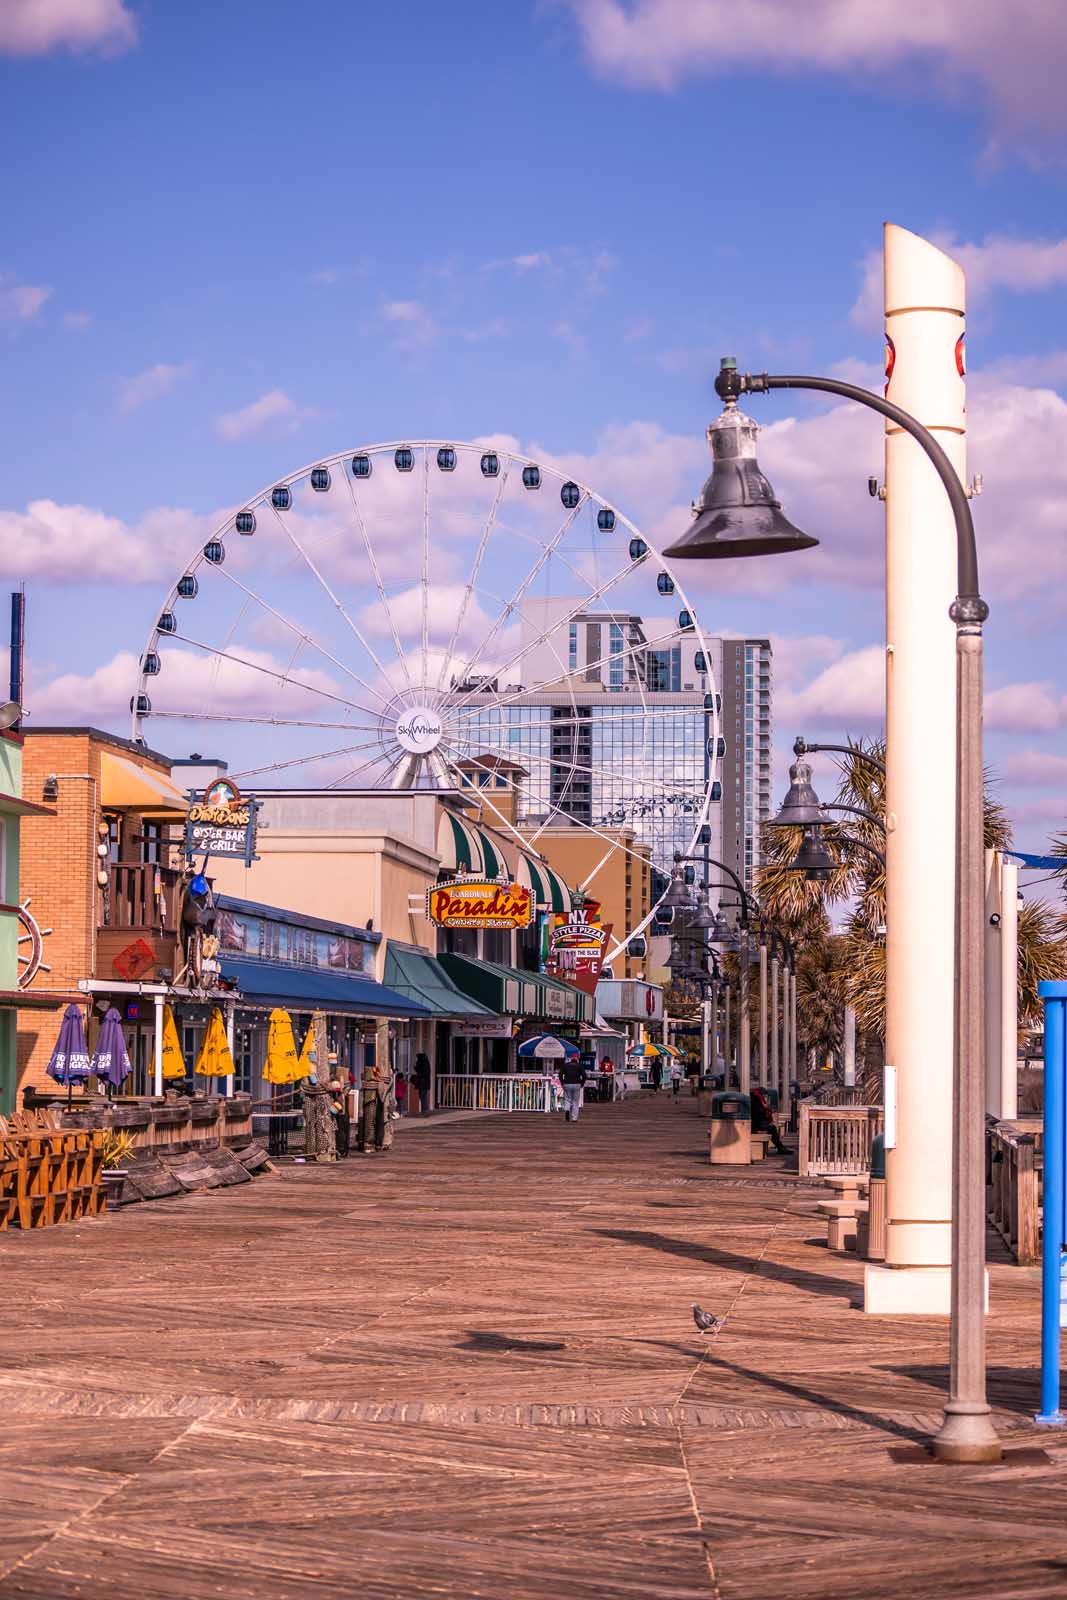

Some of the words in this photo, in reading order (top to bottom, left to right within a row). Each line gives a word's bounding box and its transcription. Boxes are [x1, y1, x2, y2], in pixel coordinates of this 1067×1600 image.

[193, 827, 222, 839] OYSTER
[225, 831, 246, 841] BAR
[210, 840, 237, 851] GRILL
[448, 918, 484, 926] General
[568, 910, 589, 924] N.Y.
[553, 926, 578, 938] STYLE
[579, 926, 601, 938] PIZZA
